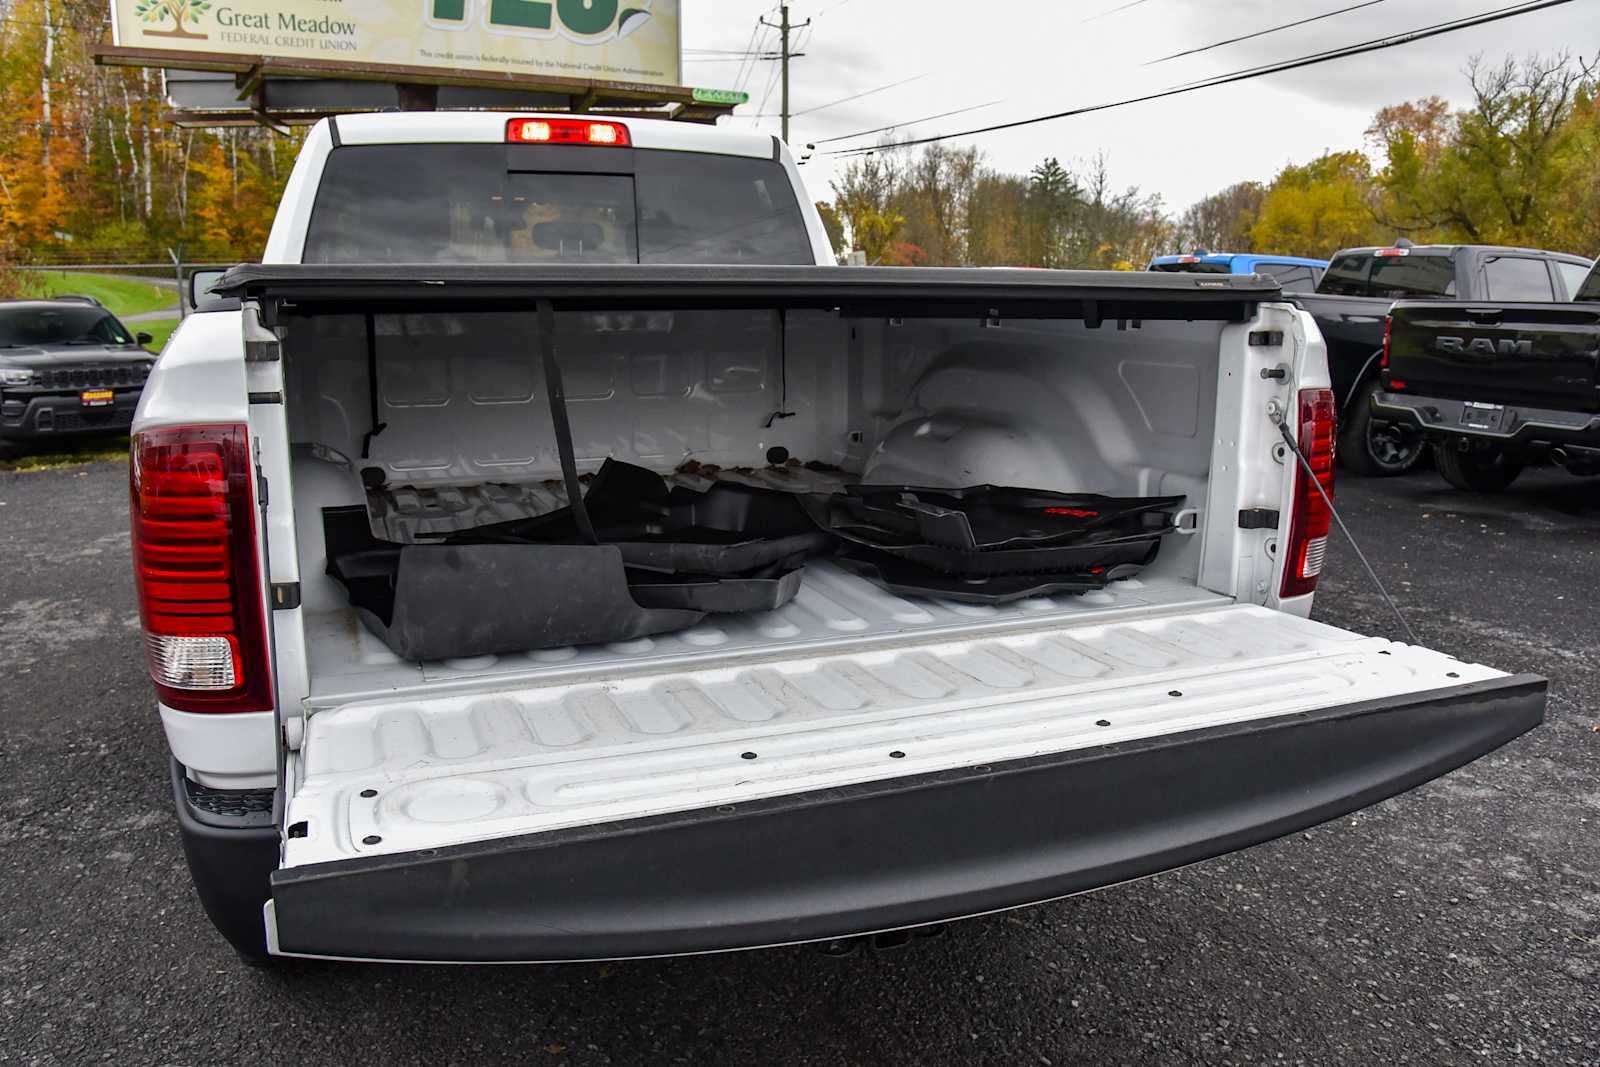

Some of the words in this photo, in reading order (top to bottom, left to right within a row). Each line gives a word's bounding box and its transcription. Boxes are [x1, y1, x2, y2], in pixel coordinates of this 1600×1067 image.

[216, 7, 271, 29] Great
[278, 12, 356, 36] Meadow
[220, 31, 271, 46] FEDERAL
[275, 36, 315, 49] CREDIT
[319, 40, 358, 51] UNION
[434, 51, 453, 60] credit
[481, 54, 510, 64] federally
[556, 61, 581, 70] National
[583, 63, 602, 71] Credit
[622, 66, 664, 77] Administration
[1436, 335, 1533, 354] RAM
